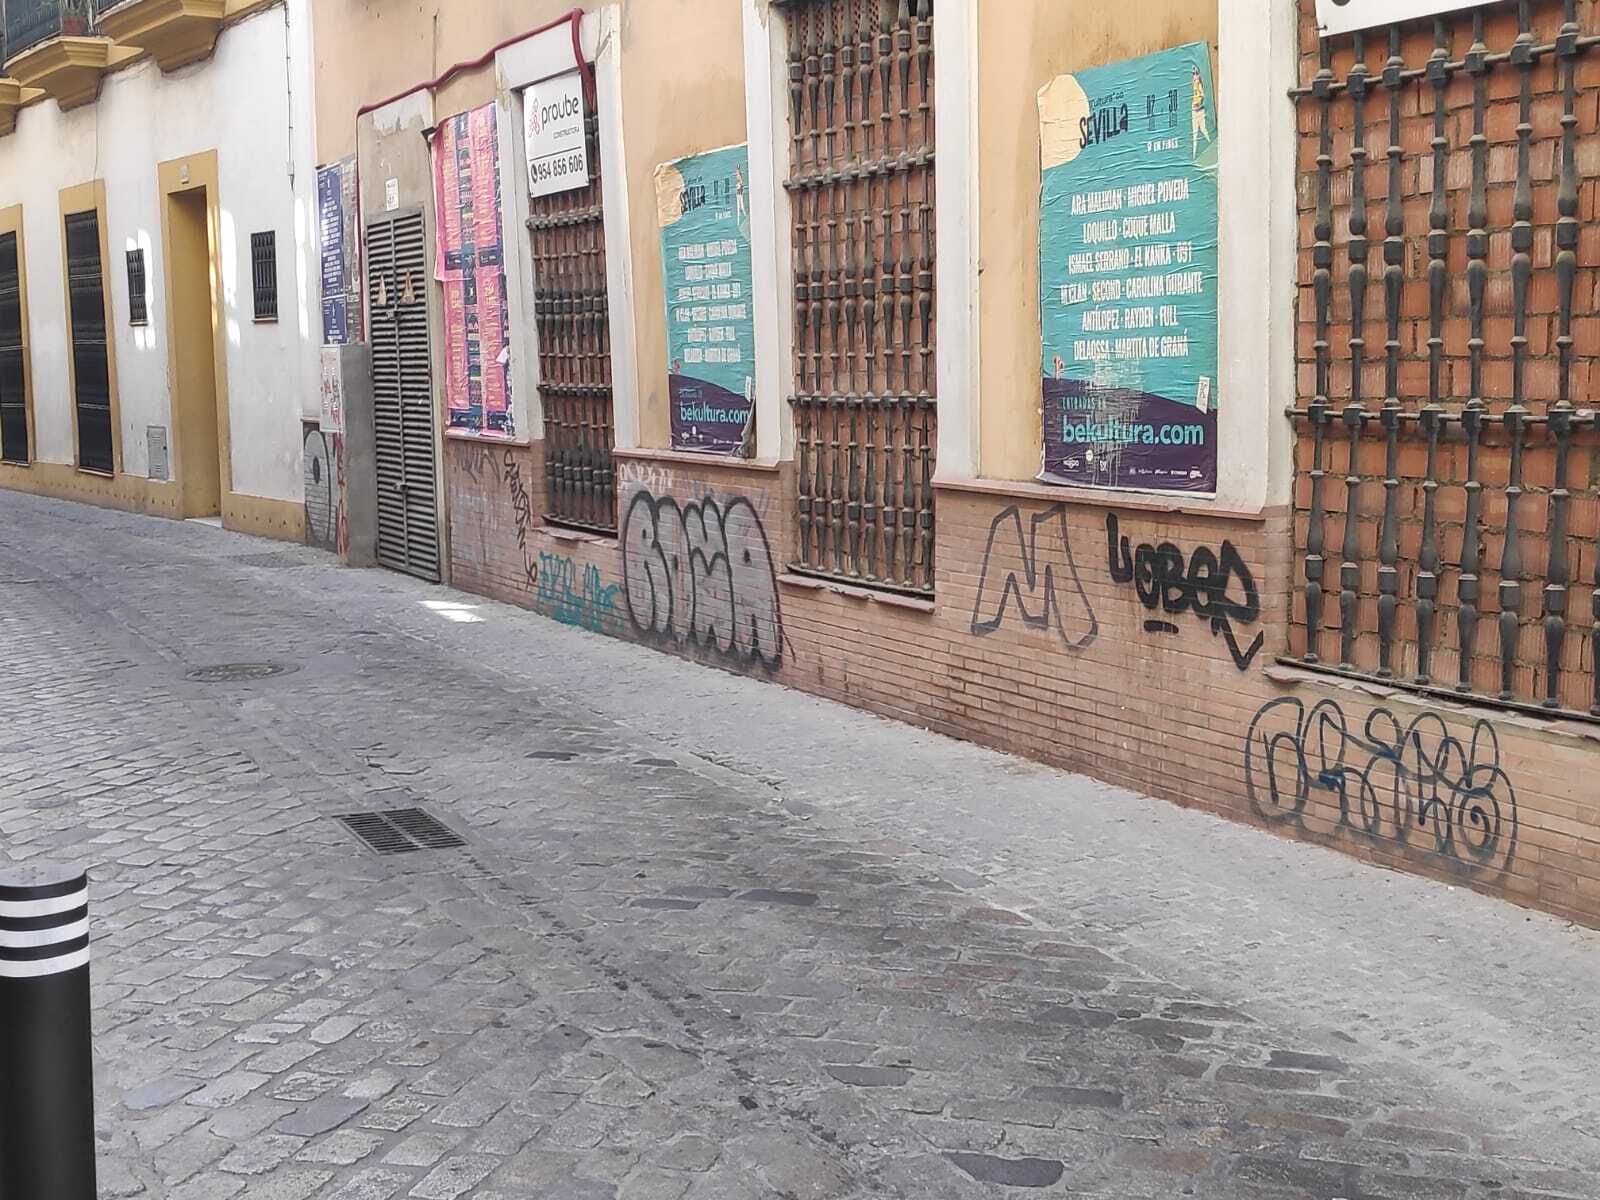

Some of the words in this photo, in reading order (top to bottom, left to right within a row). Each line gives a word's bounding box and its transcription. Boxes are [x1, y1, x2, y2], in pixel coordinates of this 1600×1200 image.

[541, 93, 579, 131] proube
[539, 162, 552, 181] 954
[553, 157, 567, 178] 856
[1128, 184, 1156, 208] MIGUEL
[1157, 178, 1189, 202] POVEDA
[1083, 219, 1118, 244] LOQUILLO
[1122, 215, 1149, 240] COQUE
[1150, 212, 1176, 235] MALLA
[1095, 248, 1130, 272] SERRANO
[1134, 246, 1143, 267] EL
[1092, 280, 1121, 301] SECOND
[1126, 275, 1164, 298] CAROLINA
[1165, 272, 1203, 295] DURANTE
[1124, 308, 1154, 329] RAYDEN
[1160, 304, 1178, 326] FULL
[1115, 336, 1148, 359] MARTITA
[1149, 336, 1159, 357] DE
[680, 400, 751, 424] bekultura.com
[1063, 414, 1204, 445] bekultura.com
